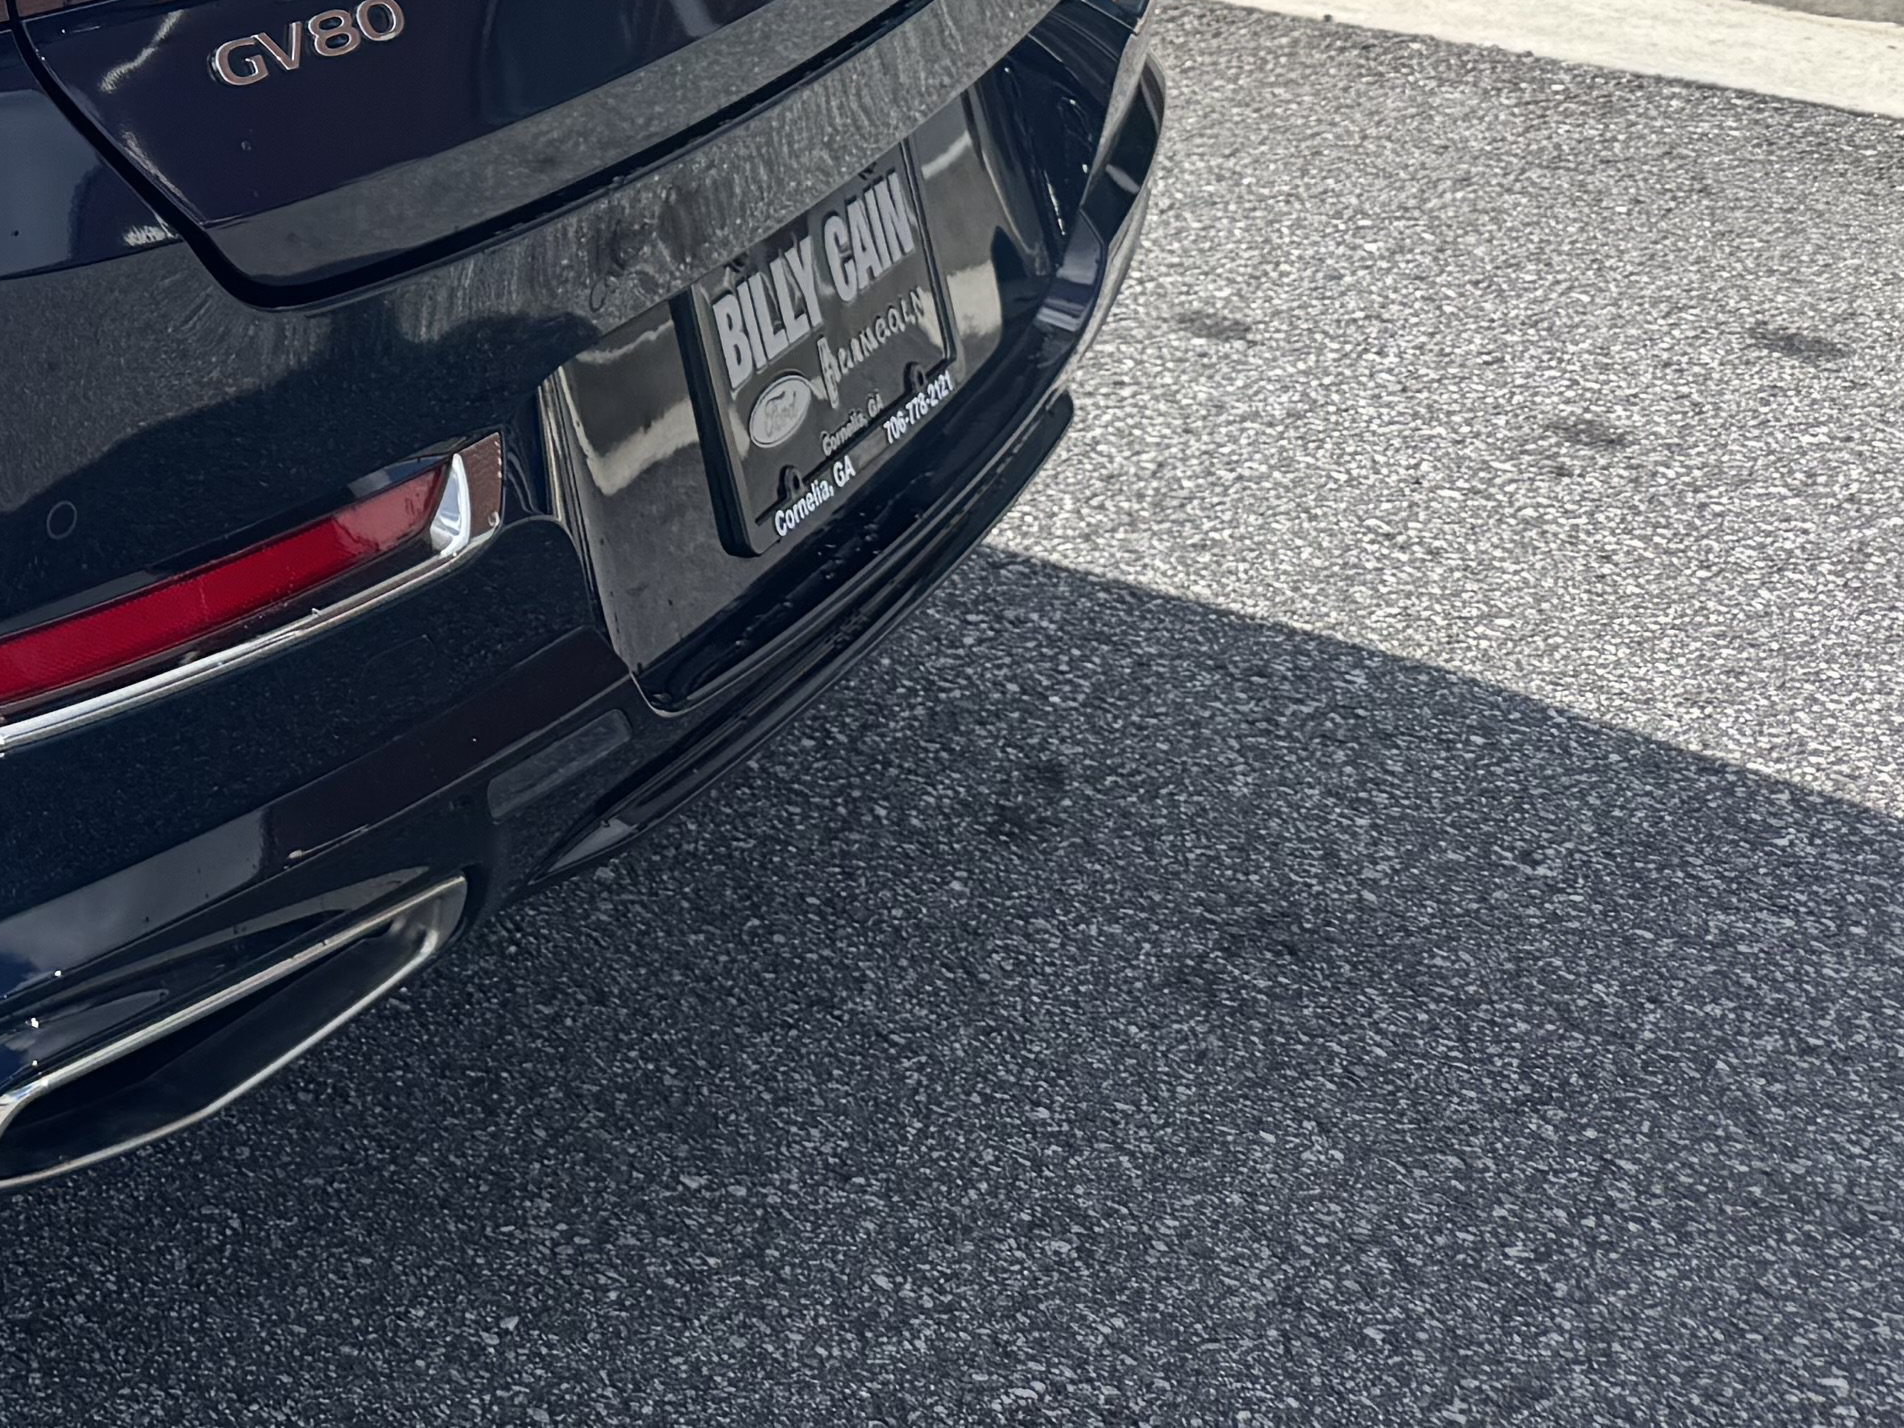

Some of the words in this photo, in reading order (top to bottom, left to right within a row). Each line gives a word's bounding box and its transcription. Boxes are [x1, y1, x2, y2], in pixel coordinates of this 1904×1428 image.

[712, 235, 823, 392] BILLY
[824, 170, 916, 302] CAIN
[866, 391, 884, 418] GA
[883, 370, 953, 445] 706-778-2121
[774, 479, 835, 537] Cornelia,
[832, 455, 857, 488] GA
